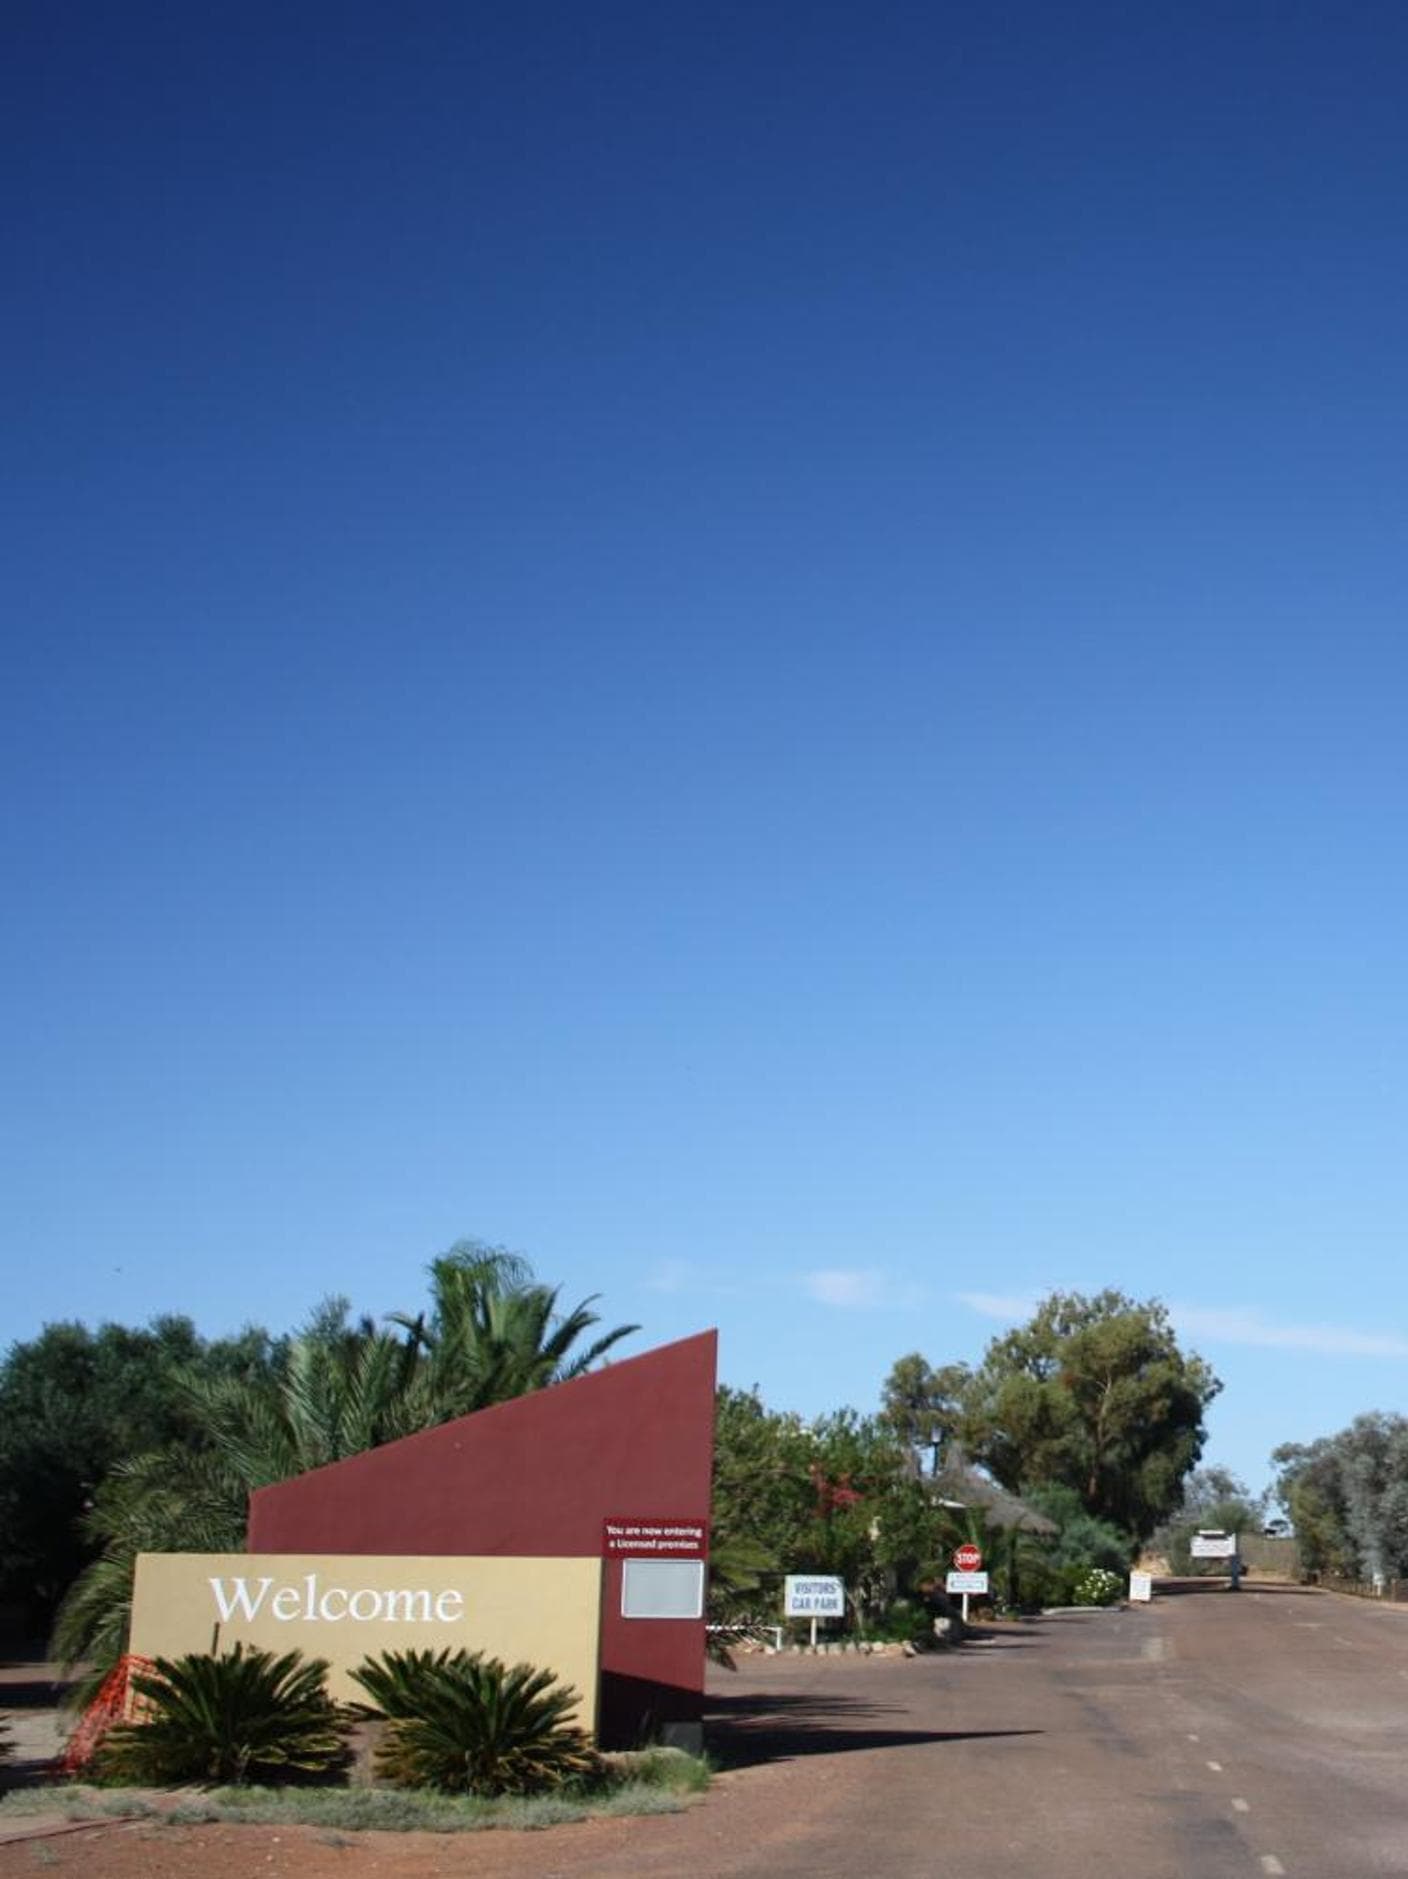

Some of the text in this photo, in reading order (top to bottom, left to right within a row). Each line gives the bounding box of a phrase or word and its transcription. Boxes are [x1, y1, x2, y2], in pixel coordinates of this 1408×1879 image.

[606, 1525, 702, 1538] You are now entering
[609, 1538, 699, 1550] a Licensed premises
[956, 1552, 980, 1565] STOP
[794, 1581, 836, 1594] VISITORS
[209, 1574, 464, 1622] Welcome
[791, 1596, 838, 1609] CAR PARK
